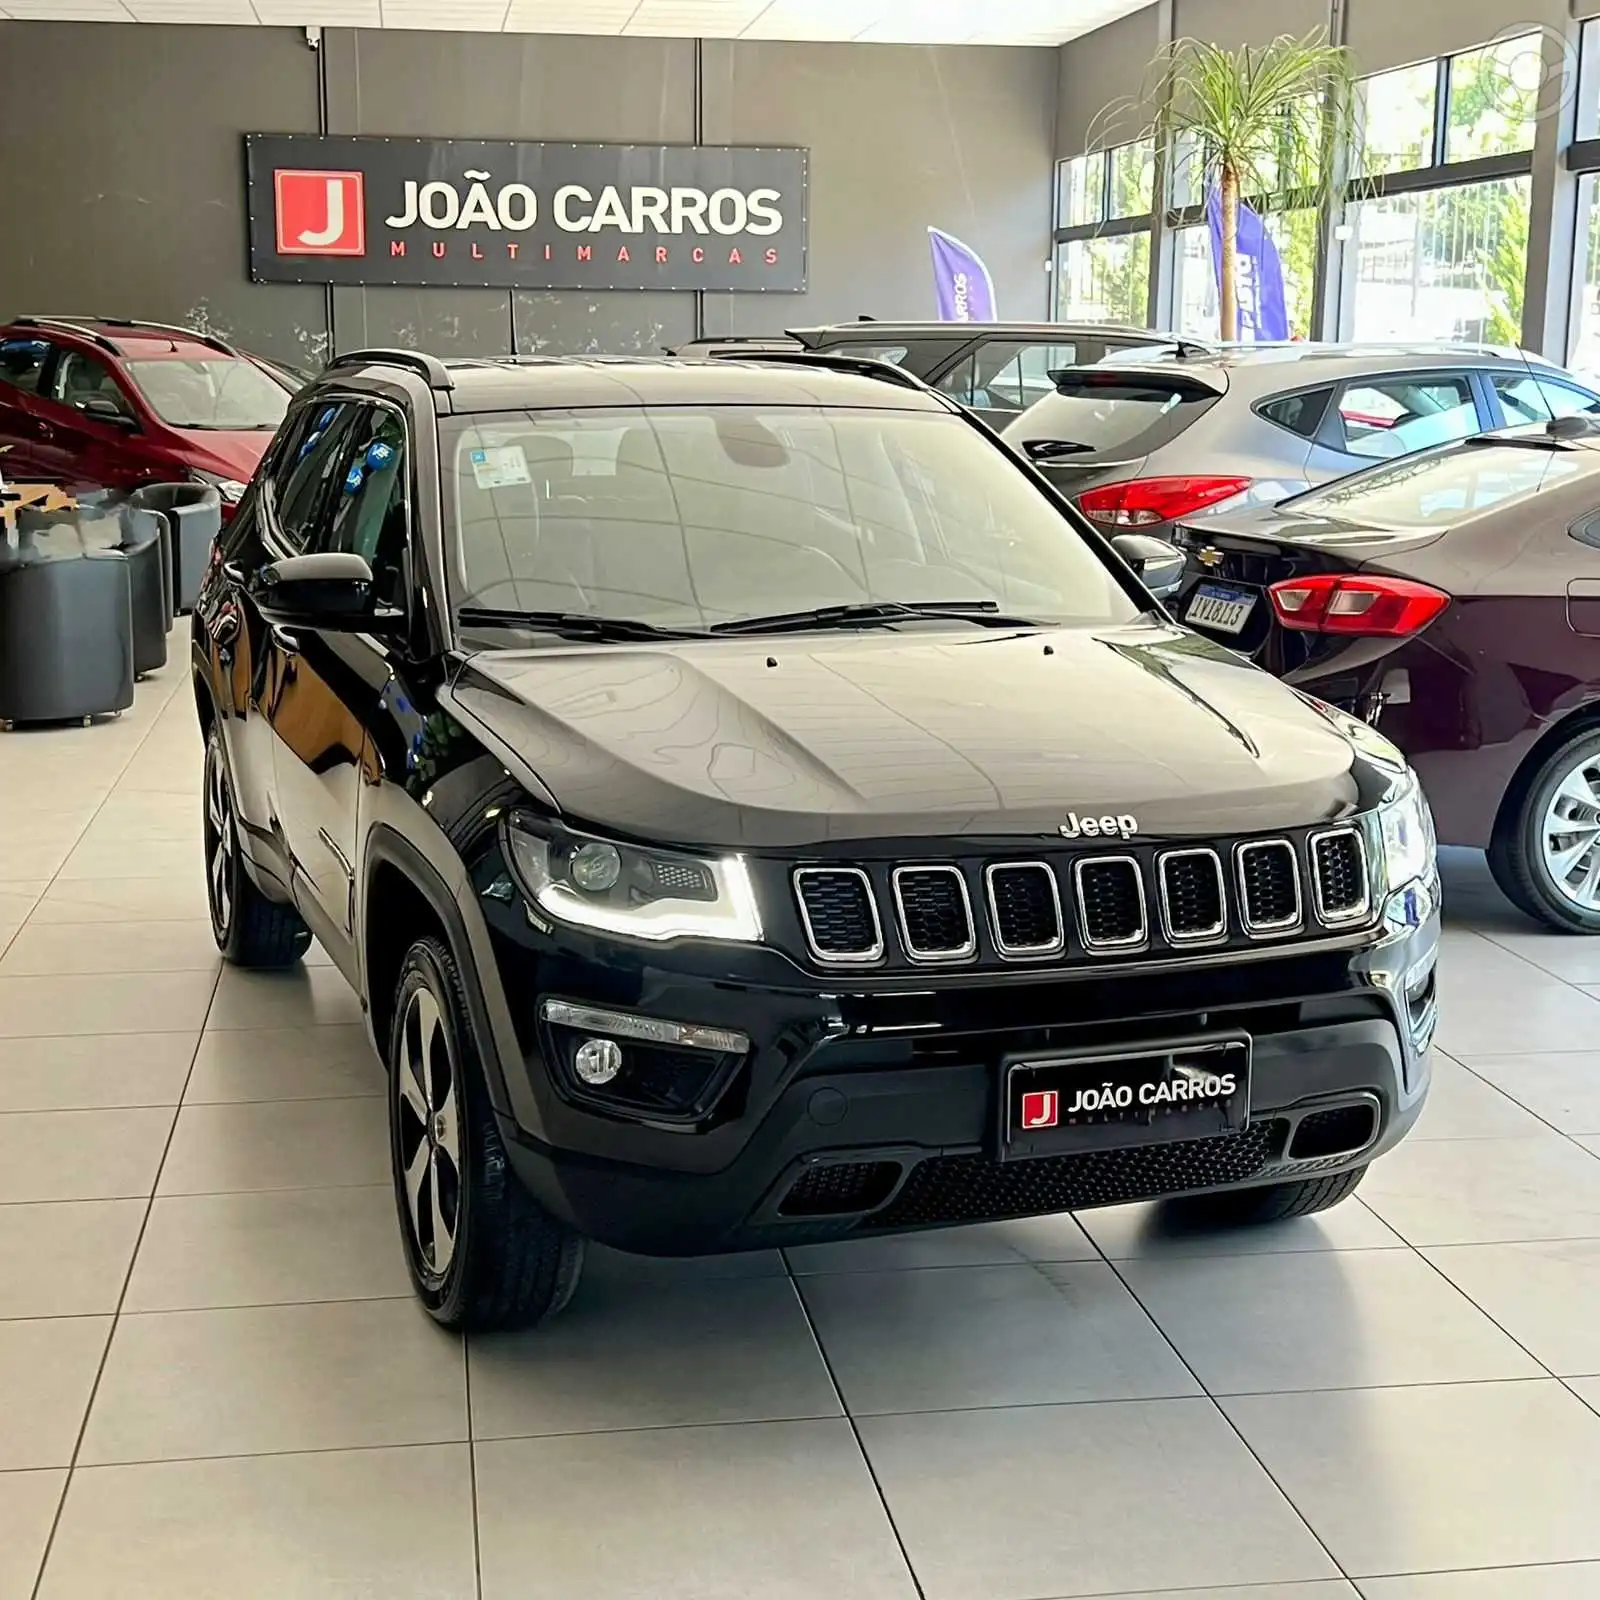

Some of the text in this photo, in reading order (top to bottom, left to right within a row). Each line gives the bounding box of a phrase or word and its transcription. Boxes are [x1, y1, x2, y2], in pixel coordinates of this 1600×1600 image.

[384, 170, 783, 236] JOÃO CARROS
[390, 241, 778, 265] MULTIMARCAS
[1059, 811, 1138, 839] Jeep
[1067, 1073, 1237, 1113] JOÃO CARROS
